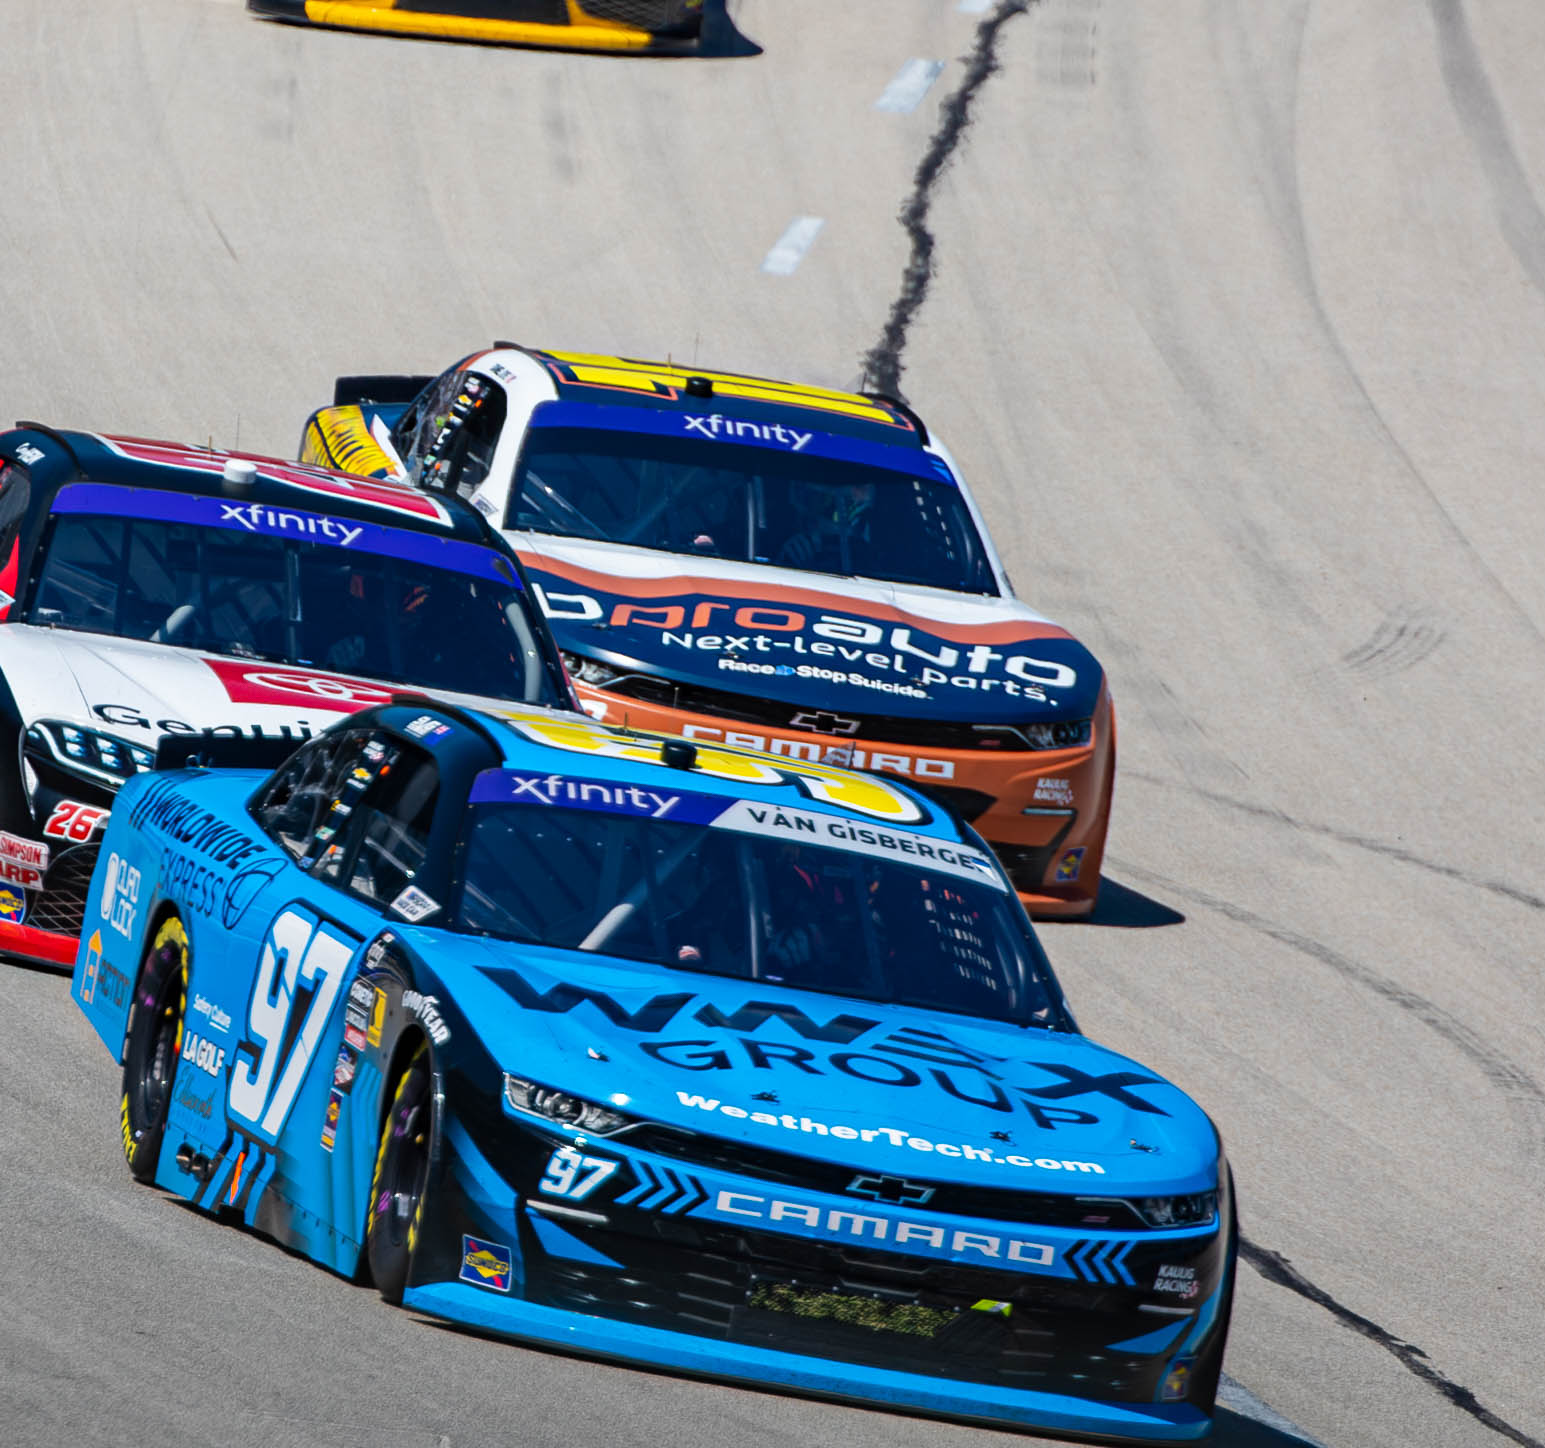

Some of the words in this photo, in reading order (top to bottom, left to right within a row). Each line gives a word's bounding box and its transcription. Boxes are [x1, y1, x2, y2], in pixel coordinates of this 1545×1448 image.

[684, 413, 813, 450] xfinity
[219, 503, 364, 545] xfinity
[662, 629, 908, 674] Next-level
[718, 657, 776, 676] Race
[795, 664, 848, 684] Stop
[92, 703, 313, 739] Genui
[511, 774, 681, 818] xfinity
[45, 801, 104, 843] 26
[150, 792, 268, 870] WORLDWIDE
[746, 807, 817, 834] VAN
[828, 822, 985, 873] GISBERGE
[160, 847, 222, 918] EXPRESS
[229, 907, 354, 1137] 97
[475, 965, 1174, 1118] WWEX
[196, 1037, 225, 1078] GOLF
[637, 1040, 1100, 1131] GROUP
[675, 1090, 1106, 1175] WeatherTech.com
[538, 1150, 621, 1201] 97
[715, 1190, 1055, 1267] CAMARO
